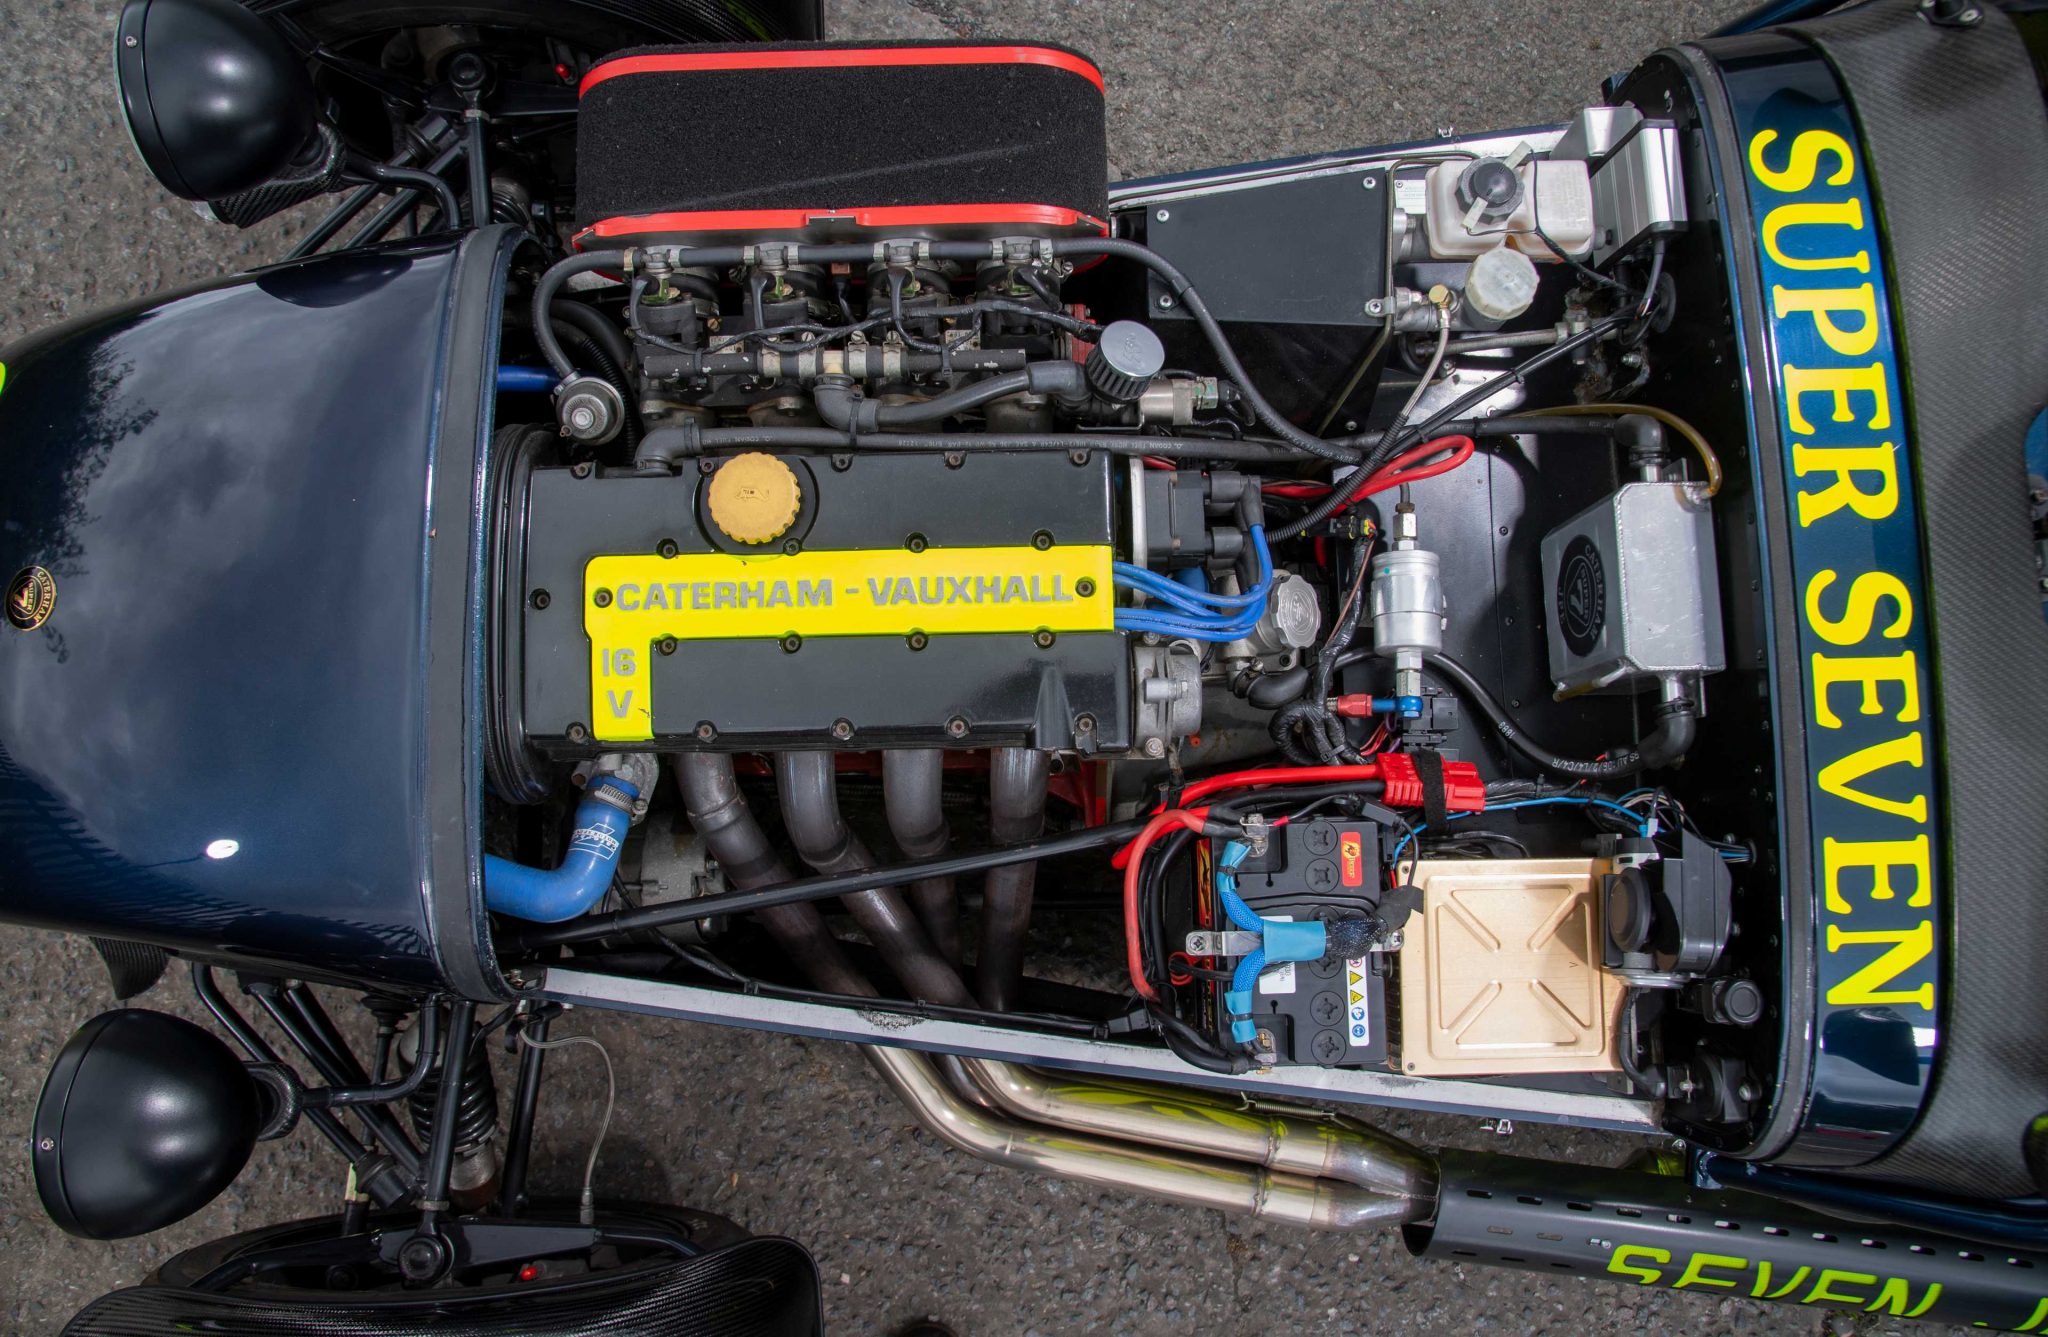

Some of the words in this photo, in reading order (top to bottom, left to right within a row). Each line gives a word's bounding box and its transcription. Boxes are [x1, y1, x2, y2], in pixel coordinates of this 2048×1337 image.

[1748, 128, 1900, 529] SUPER
[33, 571, 52, 623] CATERHAM
[614, 578, 833, 611] CATERHAM
[867, 574, 1074, 607] VAUXHALL
[602, 647, 637, 677] 16
[607, 690, 634, 719] V
[1804, 568, 1936, 1012] SEVEN
